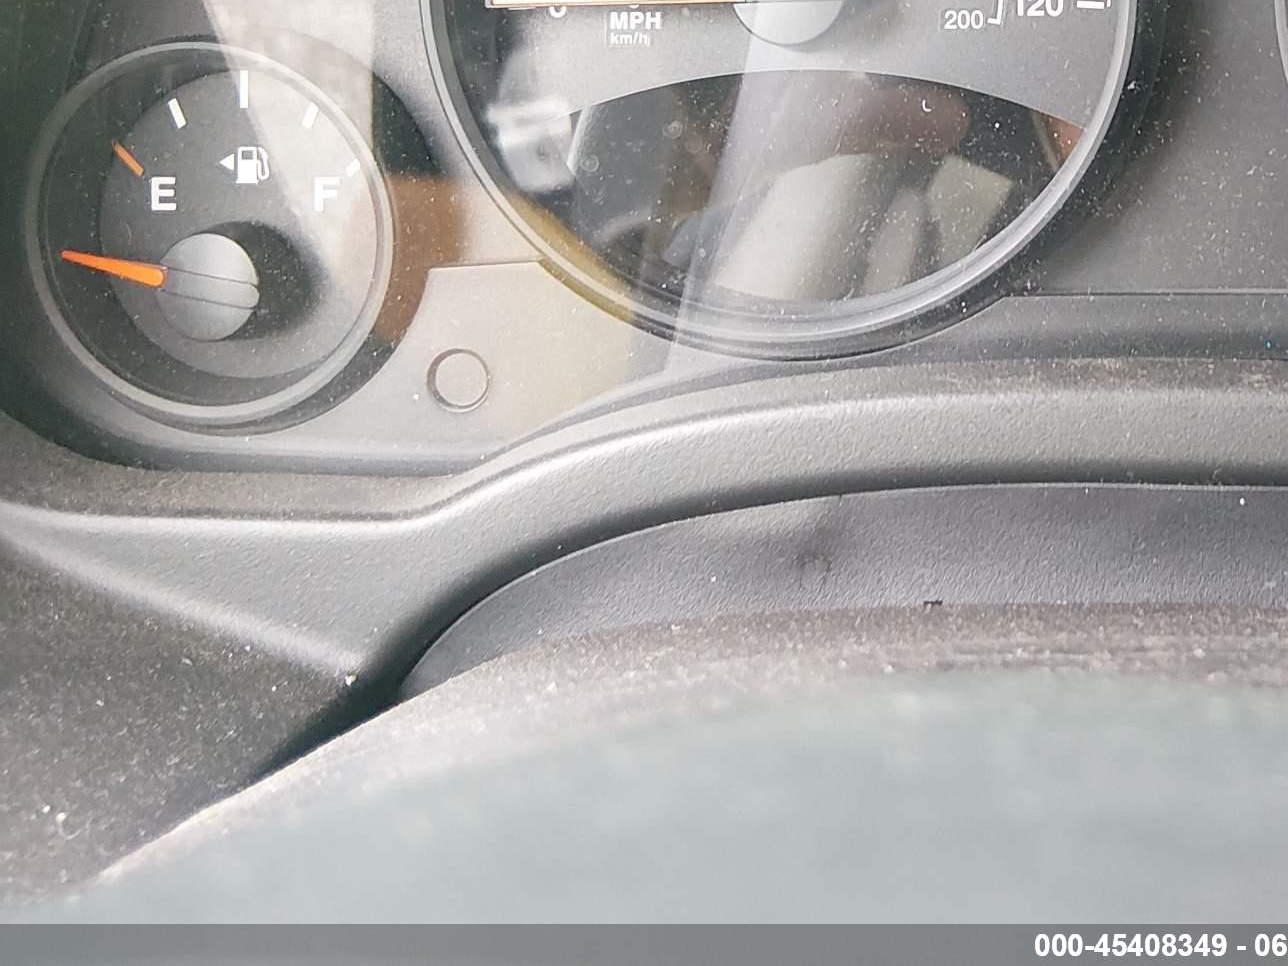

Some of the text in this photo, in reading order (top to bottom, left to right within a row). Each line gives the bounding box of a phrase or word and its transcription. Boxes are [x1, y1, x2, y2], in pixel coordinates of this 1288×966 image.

[609, 11, 662, 31] MPH
[943, 10, 984, 31] 200
[610, 31, 648, 46] km/h
[150, 176, 177, 211] E
[314, 176, 341, 212] F
